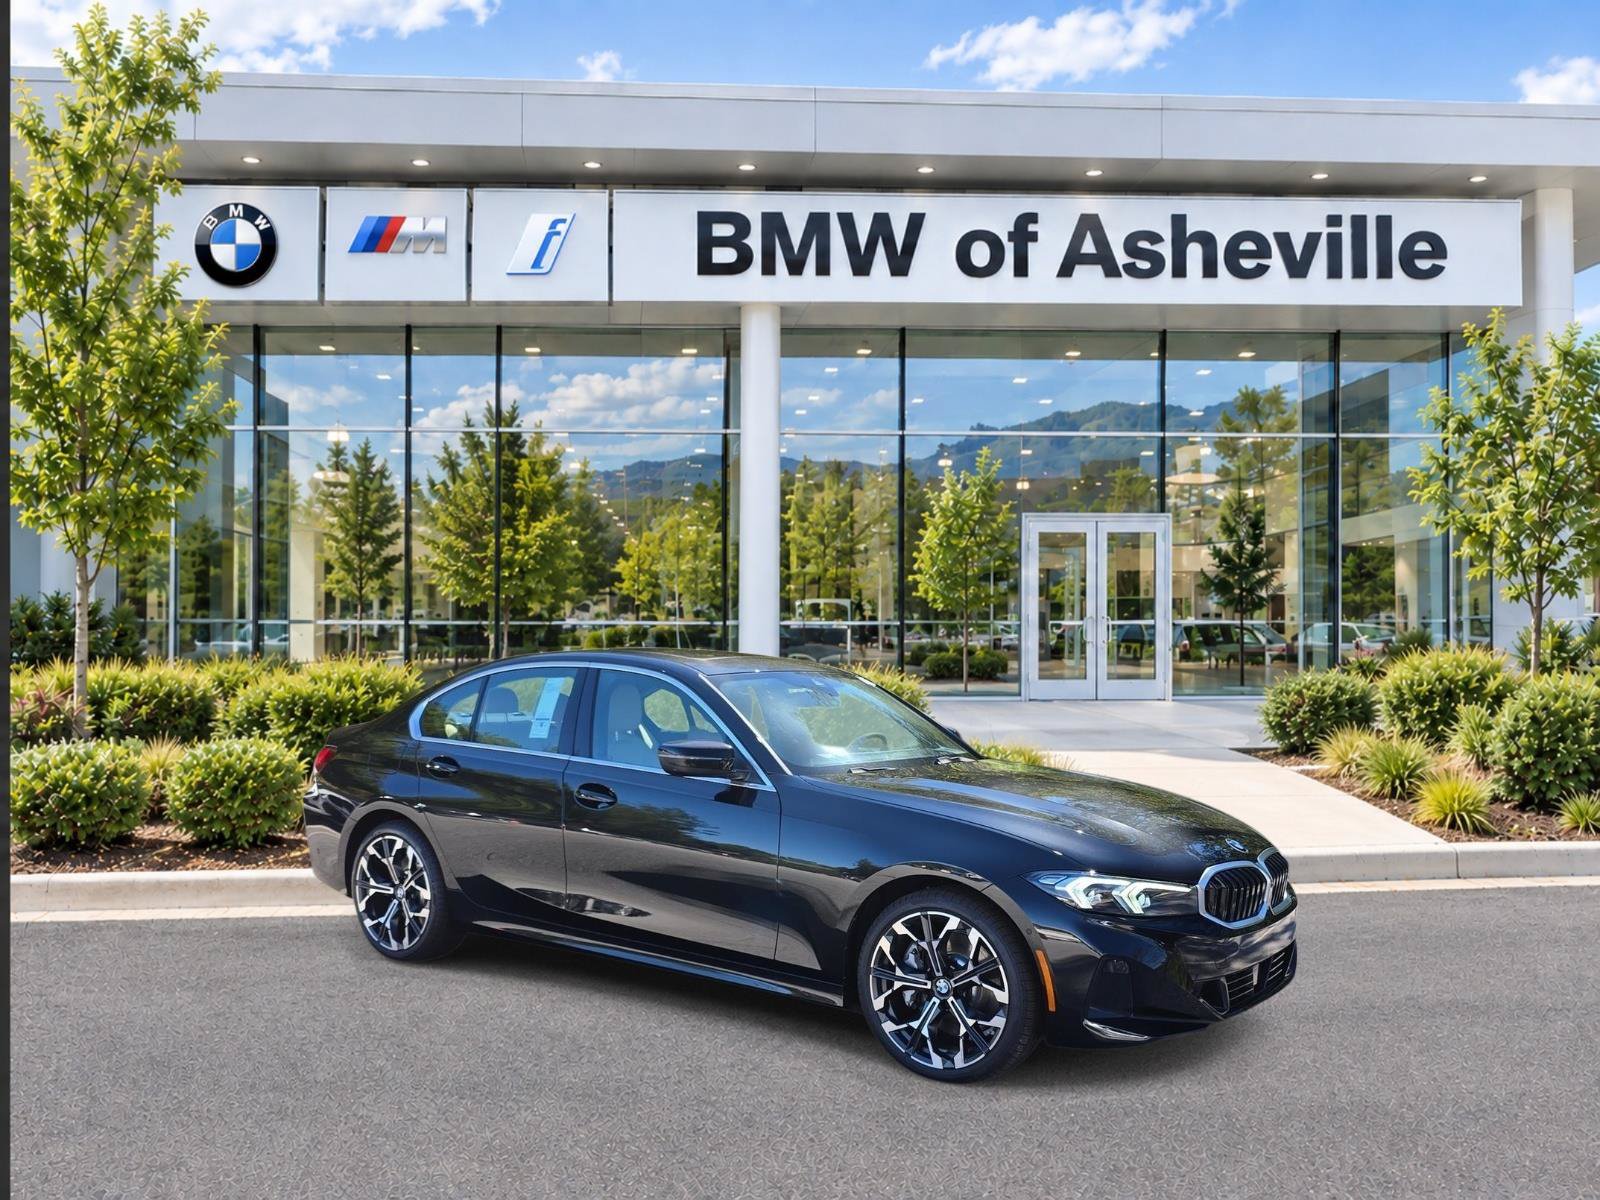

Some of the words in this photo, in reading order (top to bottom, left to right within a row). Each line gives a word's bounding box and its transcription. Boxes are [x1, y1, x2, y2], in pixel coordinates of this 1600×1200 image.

[203, 204, 271, 231] BMW
[389, 216, 447, 253] M
[697, 210, 926, 277] BMW
[955, 212, 1038, 278] of
[1056, 213, 1448, 280] Asheville
